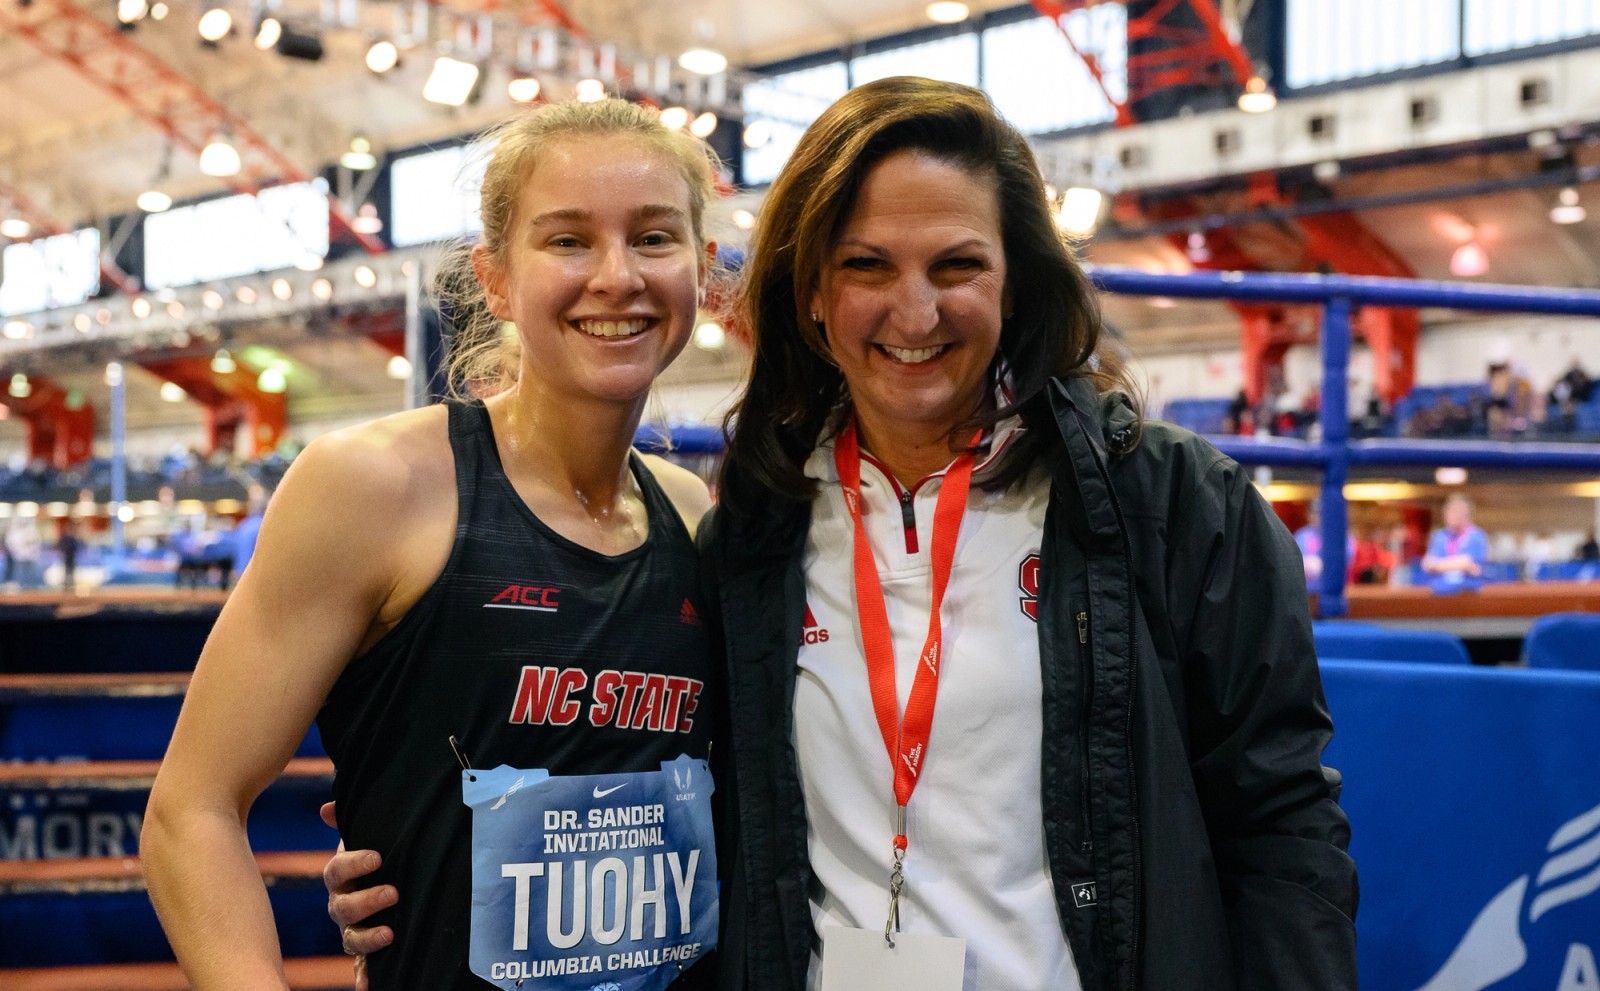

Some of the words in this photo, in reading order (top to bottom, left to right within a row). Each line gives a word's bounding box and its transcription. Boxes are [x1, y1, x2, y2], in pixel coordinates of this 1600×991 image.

[492, 584, 561, 606] ACC
[508, 665, 589, 726] NC
[589, 669, 704, 734] STATE
[909, 747, 917, 759] THE
[912, 742, 923, 767] ARMORY
[675, 792, 696, 801] USATF
[543, 809, 583, 831] DR.
[587, 804, 665, 826] SANDER
[543, 827, 665, 854] INVITATIONAL
[501, 848, 702, 951] TUOHY
[490, 954, 603, 980] COLUMBIA
[606, 942, 702, 971] CHALLENGE
